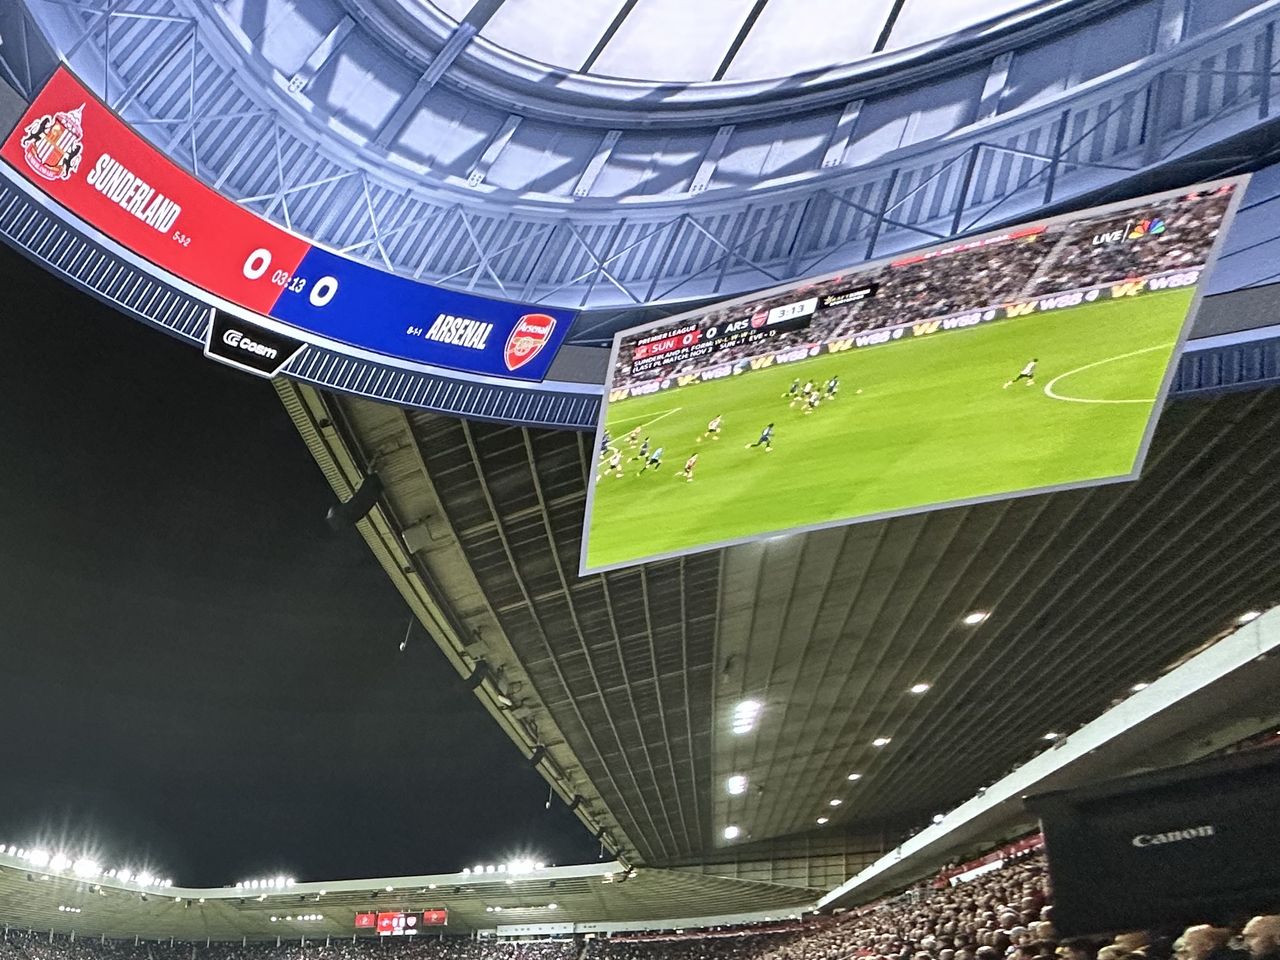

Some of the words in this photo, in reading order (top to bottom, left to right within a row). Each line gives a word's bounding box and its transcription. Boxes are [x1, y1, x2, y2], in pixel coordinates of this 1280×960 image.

[86, 153, 182, 234] SUNDERLAND
[172, 231, 192, 248] 5-3-2
[1092, 230, 1123, 245] LIVE
[242, 248, 272, 280] 0
[271, 269, 307, 294] 03:13
[309, 276, 339, 307] 0
[425, 313, 493, 350] ARSENAL
[519, 322, 550, 335] Arsenal
[651, 340, 675, 353] SUN
[682, 333, 693, 345] 0
[705, 327, 717, 339] 0
[725, 318, 750, 333] ARS
[778, 304, 805, 318] 3:13
[1132, 825, 1216, 847] Canon
